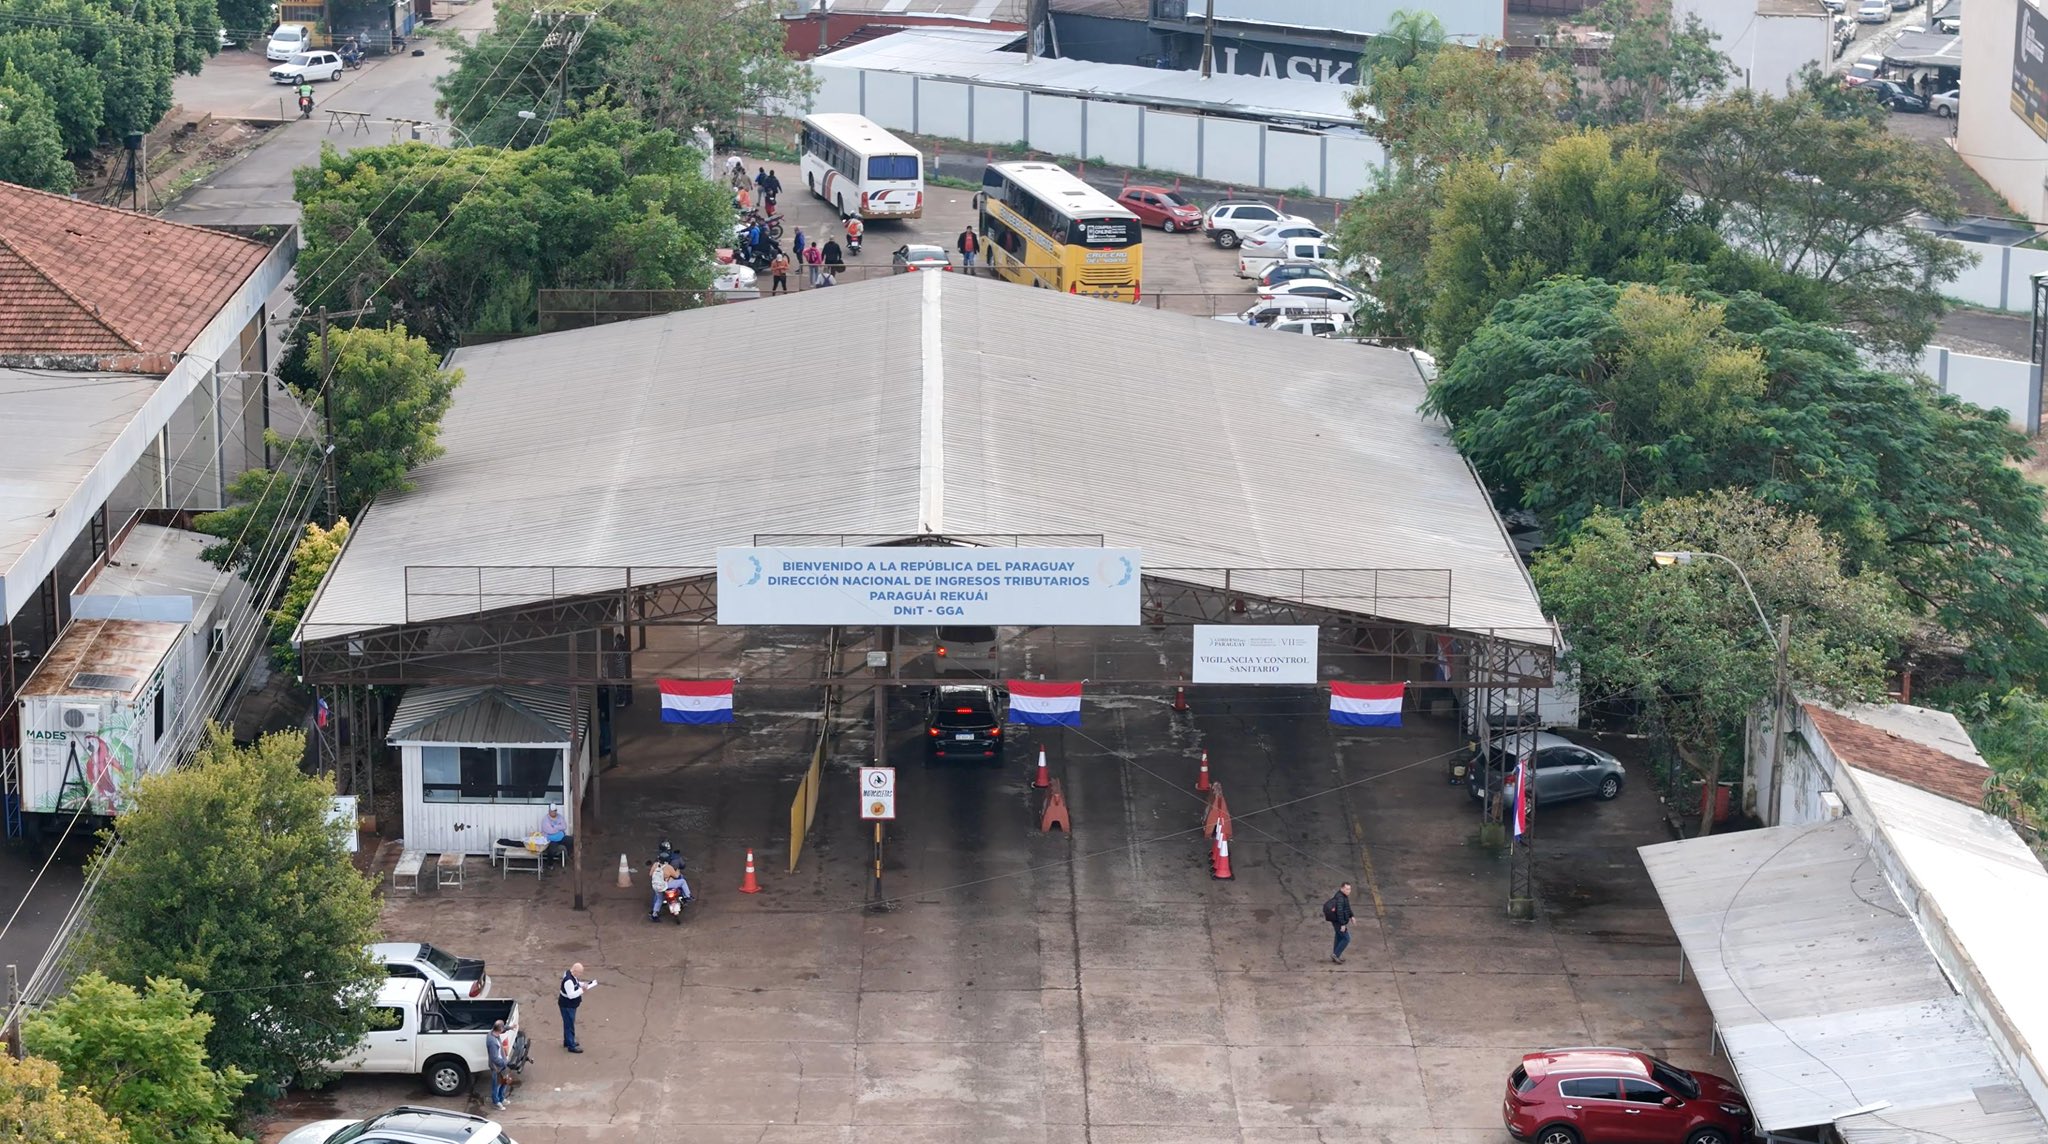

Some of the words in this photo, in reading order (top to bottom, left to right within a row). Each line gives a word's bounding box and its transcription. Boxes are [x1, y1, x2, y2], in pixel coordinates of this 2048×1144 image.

[782, 561, 864, 572] BIENVENIDO
[866, 561, 877, 572] A
[879, 561, 897, 572] LA
[900, 558, 973, 572] REPÚBLICA
[976, 561, 1002, 572] DEL
[1005, 561, 1075, 572] PARAGUAY
[768, 573, 839, 586] DIRECCIÓN
[842, 576, 911, 587] NACIONAL
[914, 576, 932, 586] DE
[935, 576, 1001, 586] INGRESOS
[1003, 576, 1090, 586] TRIBUTARIOS
[869, 588, 937, 601] PARAGUÁI
[940, 588, 988, 601] REKUÁI
[936, 605, 965, 616] GGA
[1280, 638, 1295, 646] VII
[1200, 656, 1254, 664] VIGILANCIA
[1255, 656, 1263, 664] Y
[1263, 656, 1310, 664] CONTROL
[1229, 665, 1280, 673] SANITARIO
[26, 729, 67, 741] MADES
